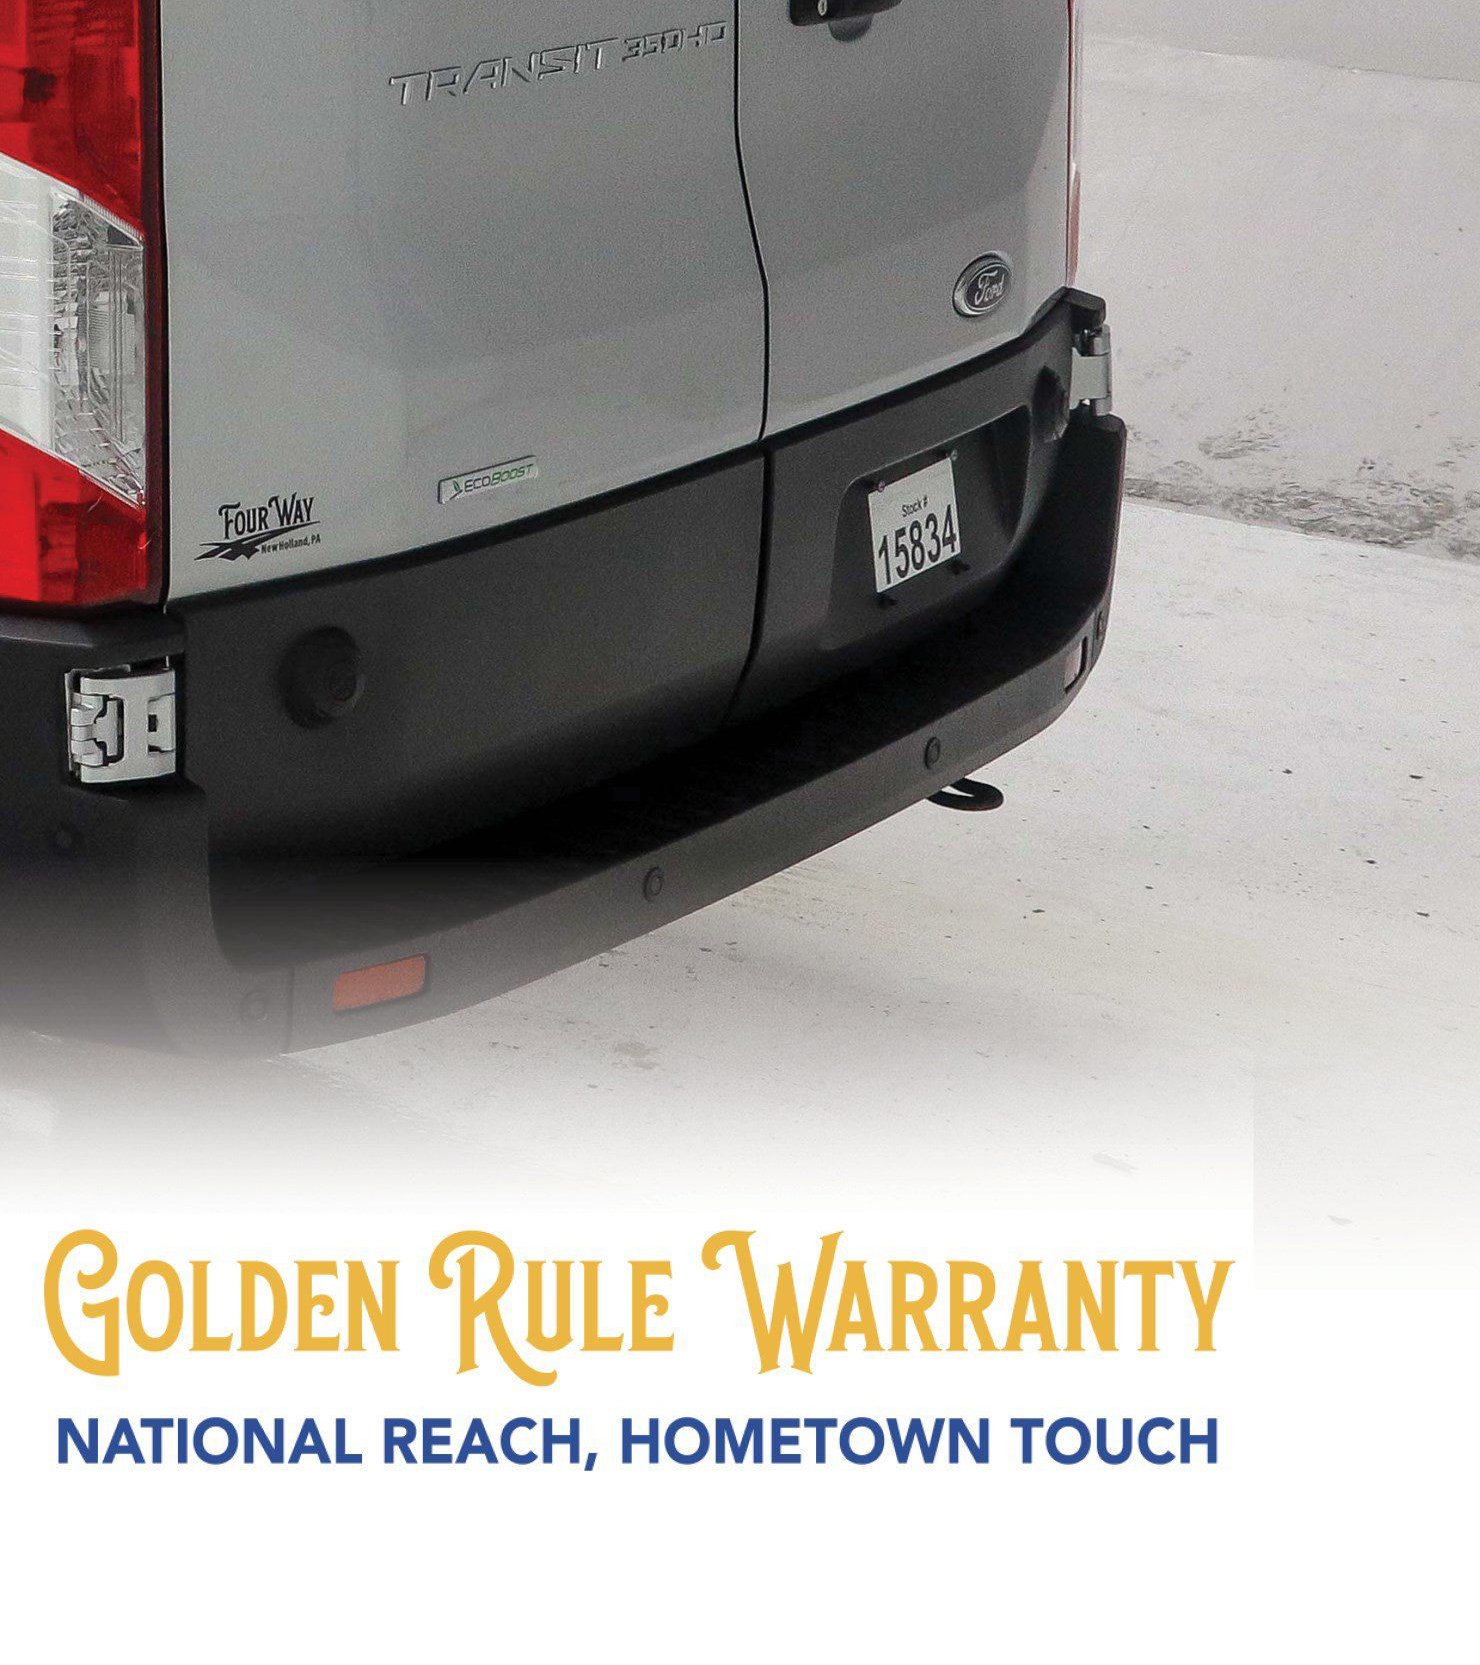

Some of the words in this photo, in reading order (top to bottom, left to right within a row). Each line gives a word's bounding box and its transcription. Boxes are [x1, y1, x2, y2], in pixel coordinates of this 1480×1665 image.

[389, 37, 619, 105] TRANSIT
[621, 20, 728, 63] 350HD
[974, 270, 1005, 306] Ford
[218, 502, 269, 539] FOUR
[268, 492, 315, 527] WAY
[901, 499, 923, 518] Stock
[922, 495, 928, 508] #
[261, 545, 278, 555] New
[278, 538, 310, 552] Holland,
[311, 534, 321, 544] PA
[878, 503, 957, 585] 15834
